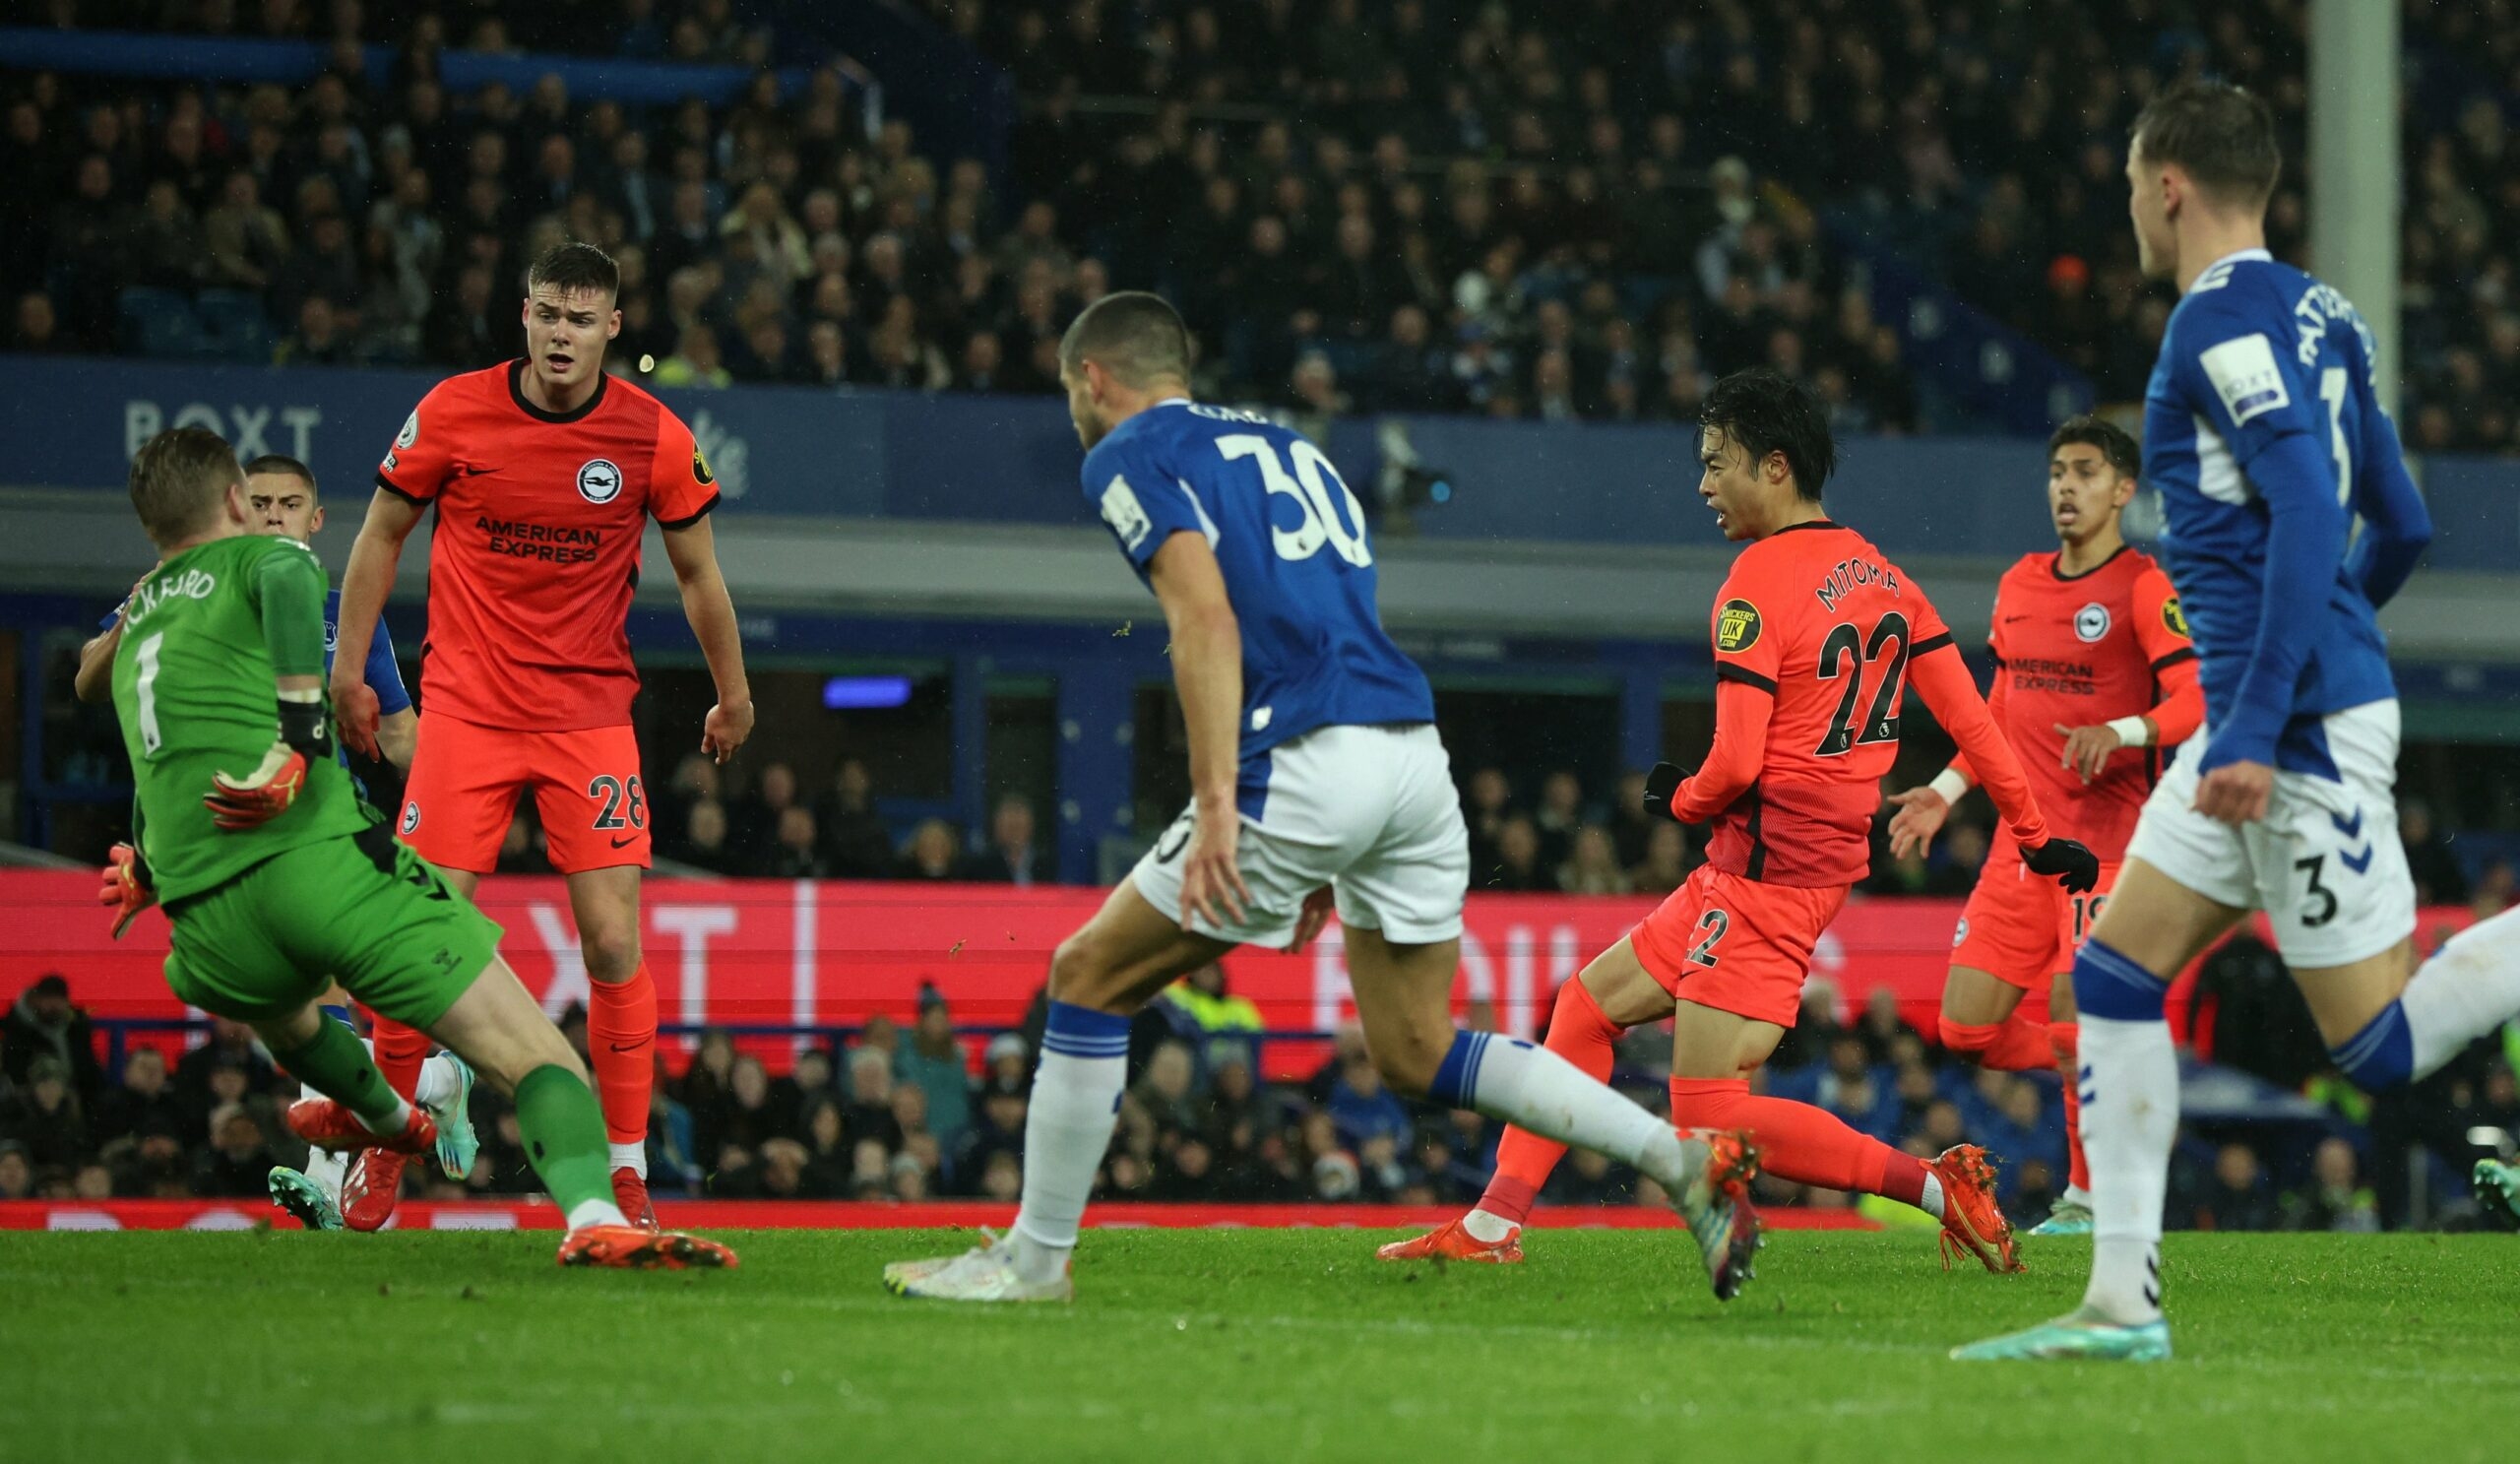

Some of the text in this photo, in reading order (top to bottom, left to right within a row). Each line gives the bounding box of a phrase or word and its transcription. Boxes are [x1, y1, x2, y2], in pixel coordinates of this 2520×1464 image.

[475, 516, 600, 546] AMERICAN
[1214, 434, 1373, 568] 30
[489, 536, 597, 564] EXPRESS
[123, 569, 216, 634] CKFORD
[1815, 558, 1900, 612] MITOMA
[1722, 620, 1742, 637] UK
[135, 631, 164, 758] 1
[1813, 611, 1910, 756] 22
[588, 774, 644, 830] 28
[2294, 853, 2338, 927] 3
[1684, 909, 1730, 969] 2
